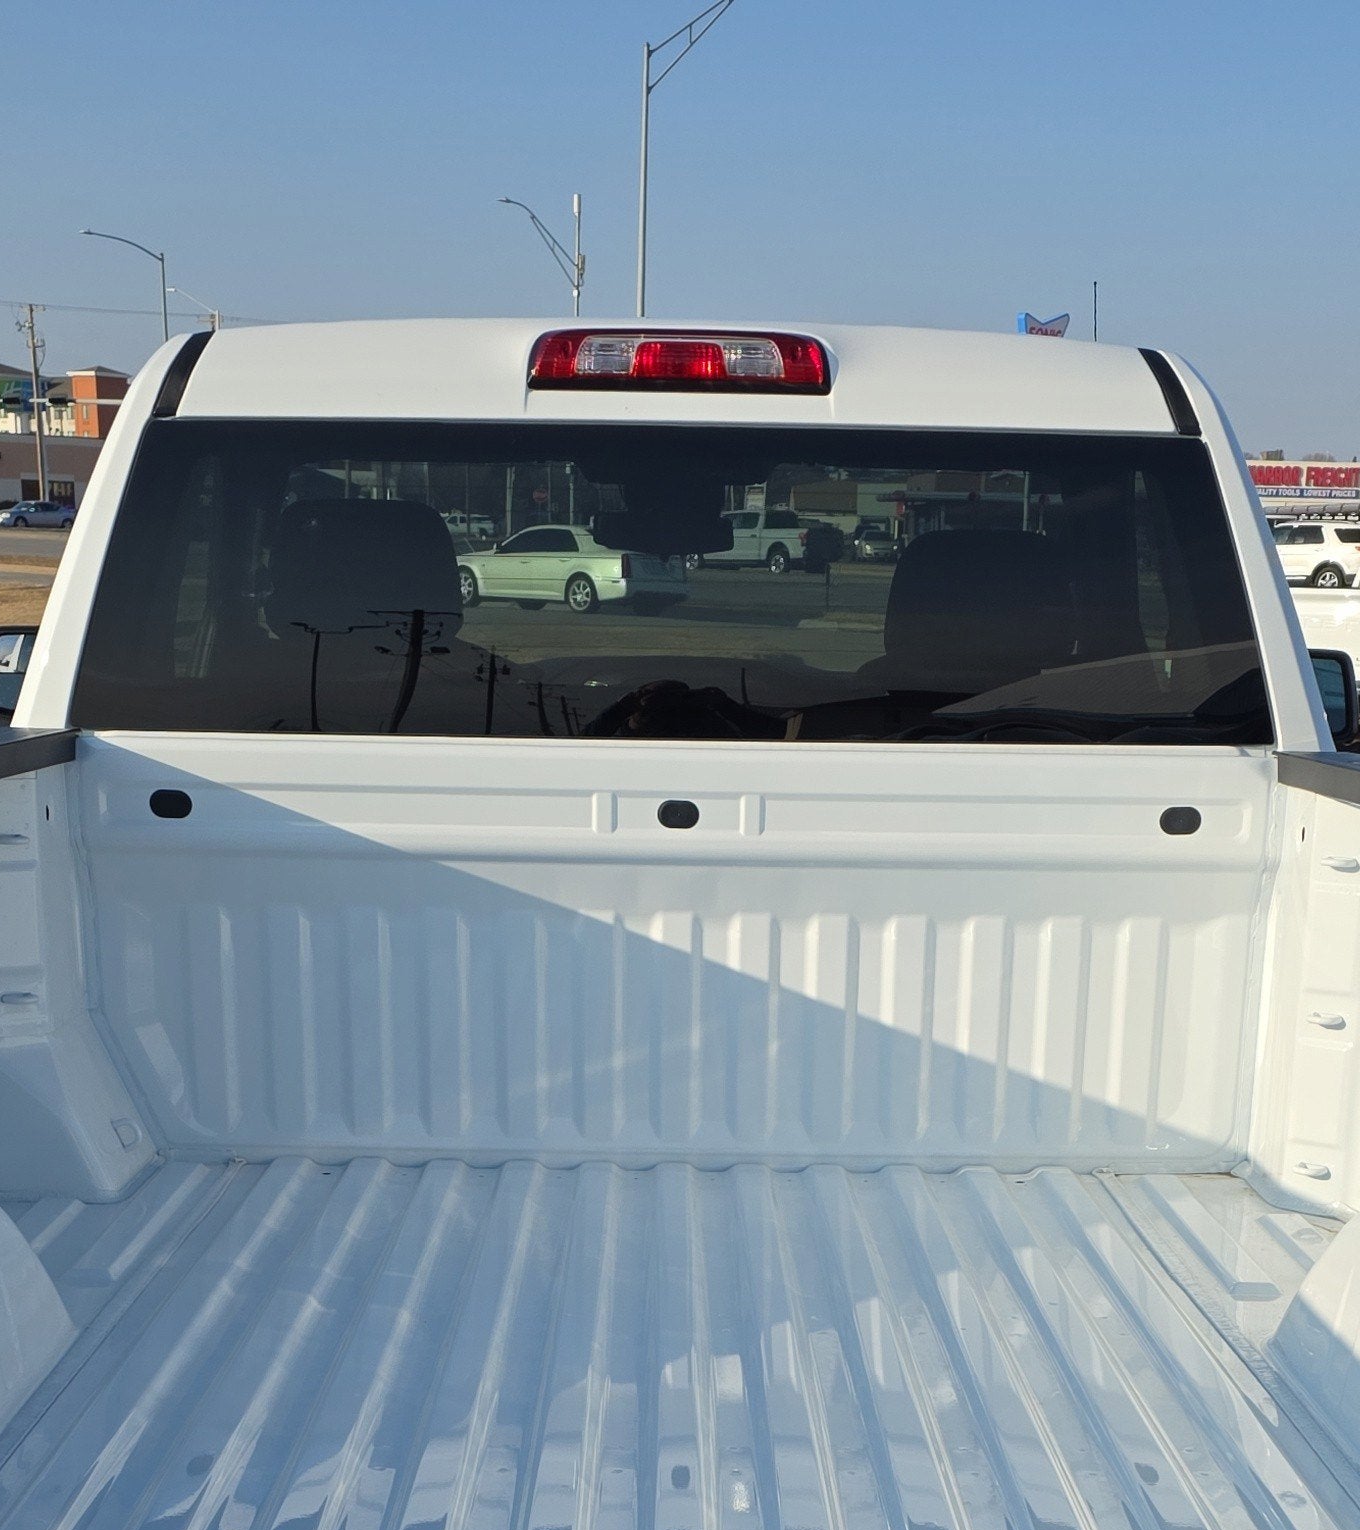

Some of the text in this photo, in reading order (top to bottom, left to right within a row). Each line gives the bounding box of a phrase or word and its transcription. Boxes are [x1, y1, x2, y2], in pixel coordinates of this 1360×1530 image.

[1279, 489, 1300, 497] TOOLS
[1303, 489, 1331, 497] LOWEST
[1332, 490, 1356, 498] PRICES
